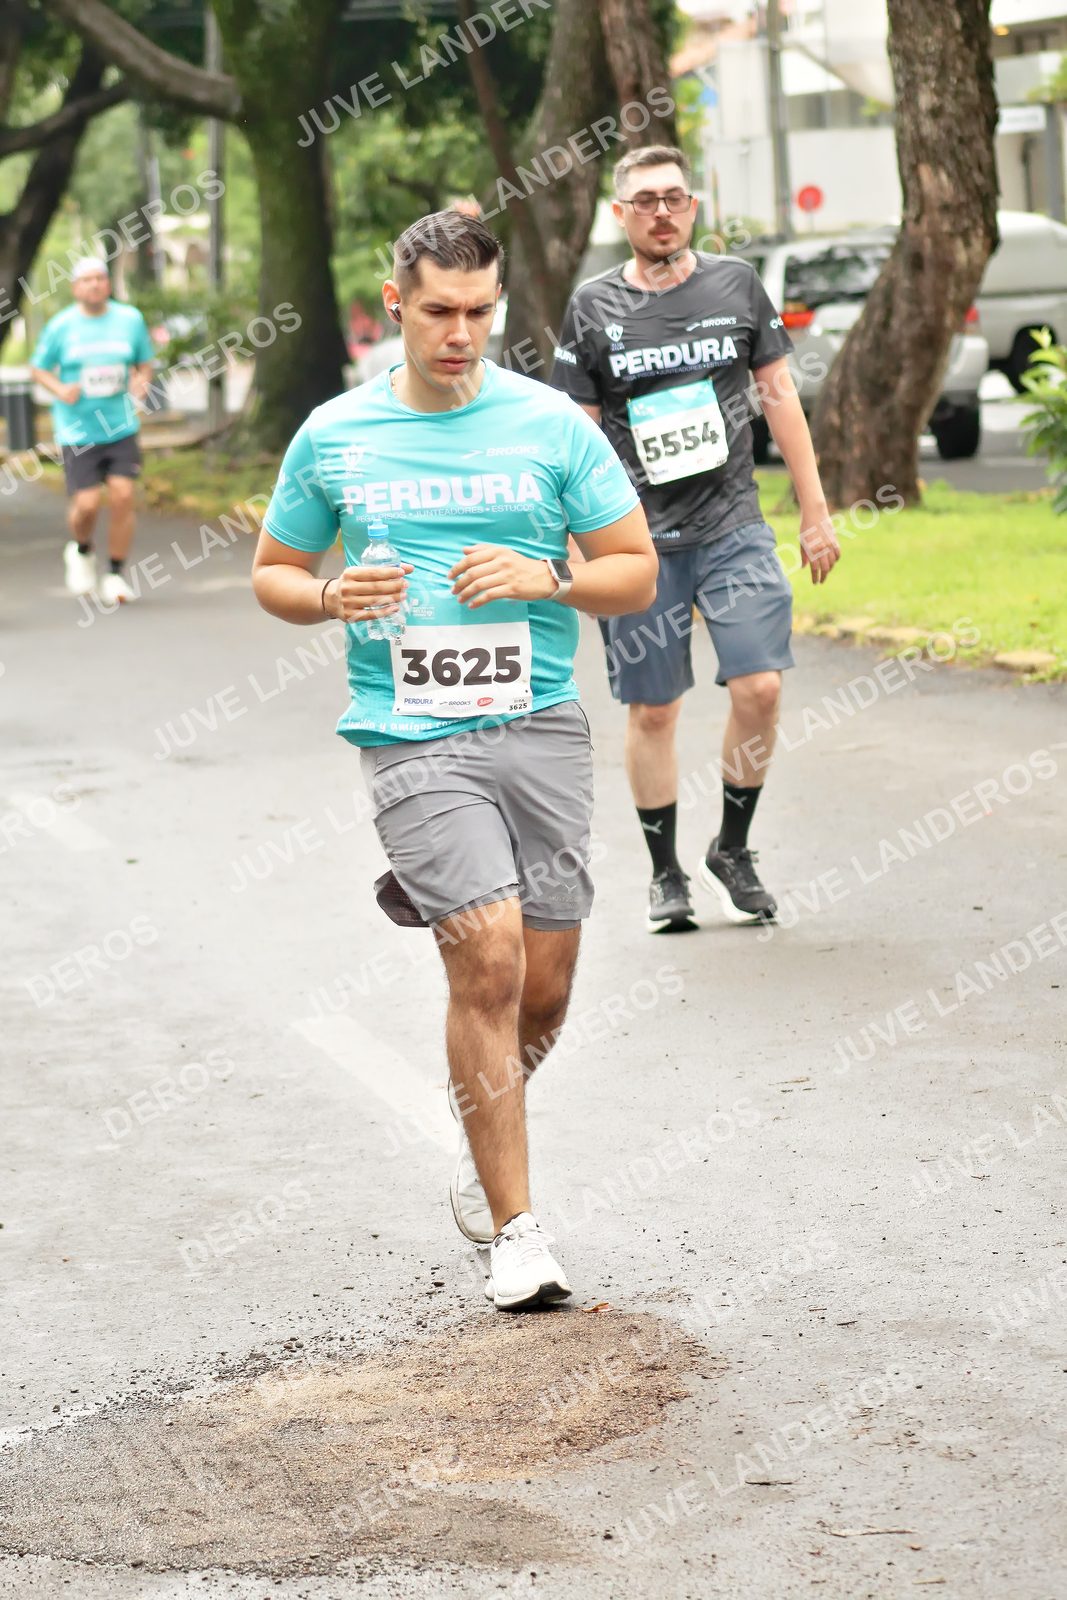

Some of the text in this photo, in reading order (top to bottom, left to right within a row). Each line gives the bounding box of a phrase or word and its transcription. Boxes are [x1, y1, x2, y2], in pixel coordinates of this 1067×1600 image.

[702, 317, 737, 328] BROOKS
[609, 336, 738, 378] PERDURA
[642, 421, 719, 463] 5554
[486, 445, 540, 457] BROOKS
[341, 470, 543, 515] PERDURA
[415, 504, 484, 517] JUNTEADORES
[491, 503, 535, 513] ESTUCOS
[401, 645, 522, 687] 3625
[404, 697, 434, 706] PERDURA
[509, 702, 528, 712] 3625
